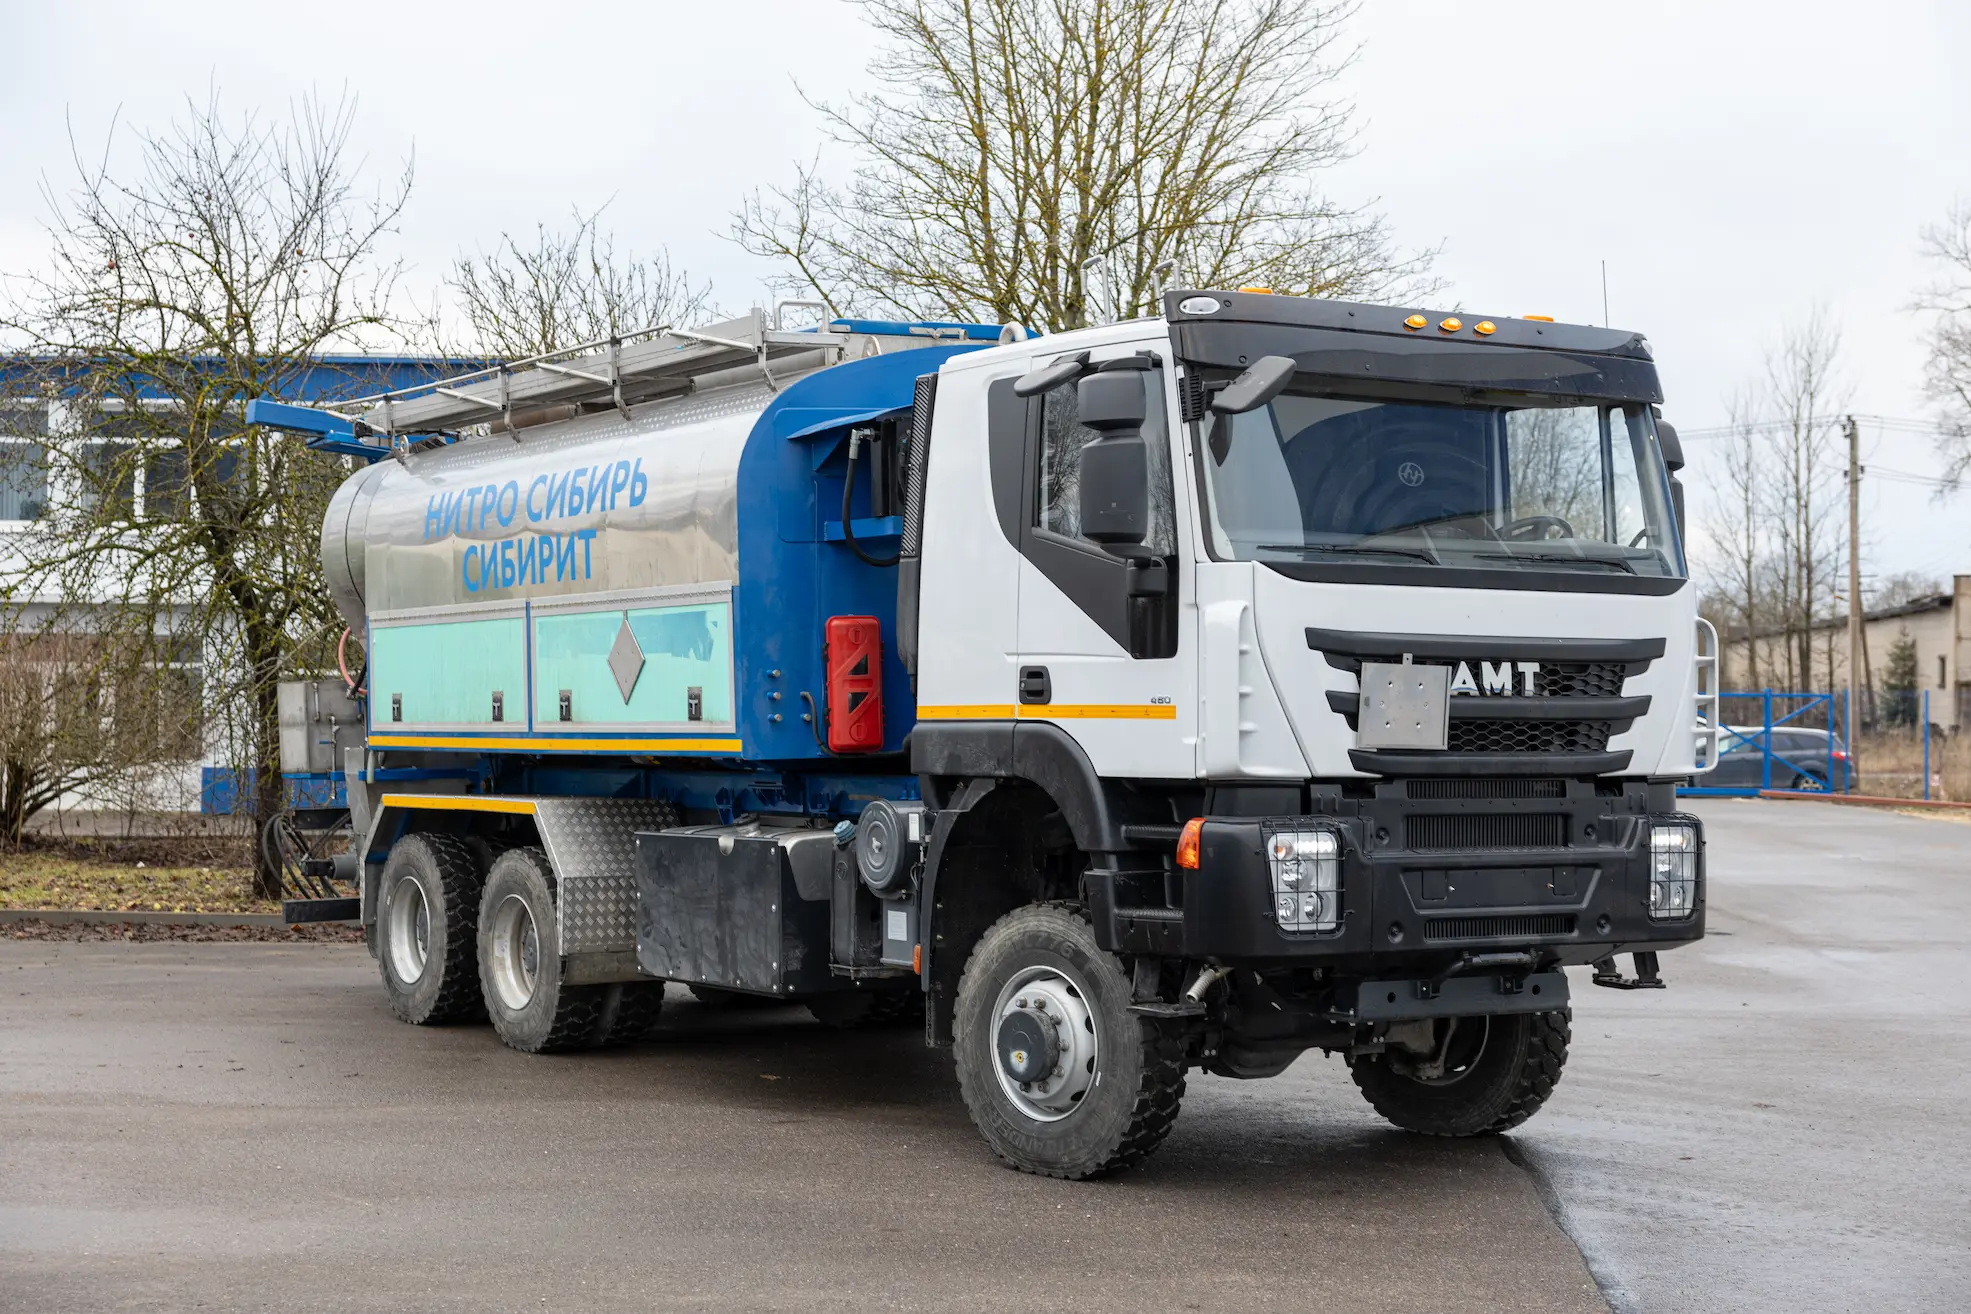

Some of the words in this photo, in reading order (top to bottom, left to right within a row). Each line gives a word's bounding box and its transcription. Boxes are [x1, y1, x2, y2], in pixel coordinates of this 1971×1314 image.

[424, 480, 518, 539] НИТРО
[526, 457, 648, 523] СИБИРЬ
[463, 528, 596, 593] СИБИРИТ
[1449, 660, 1540, 697] AMT
